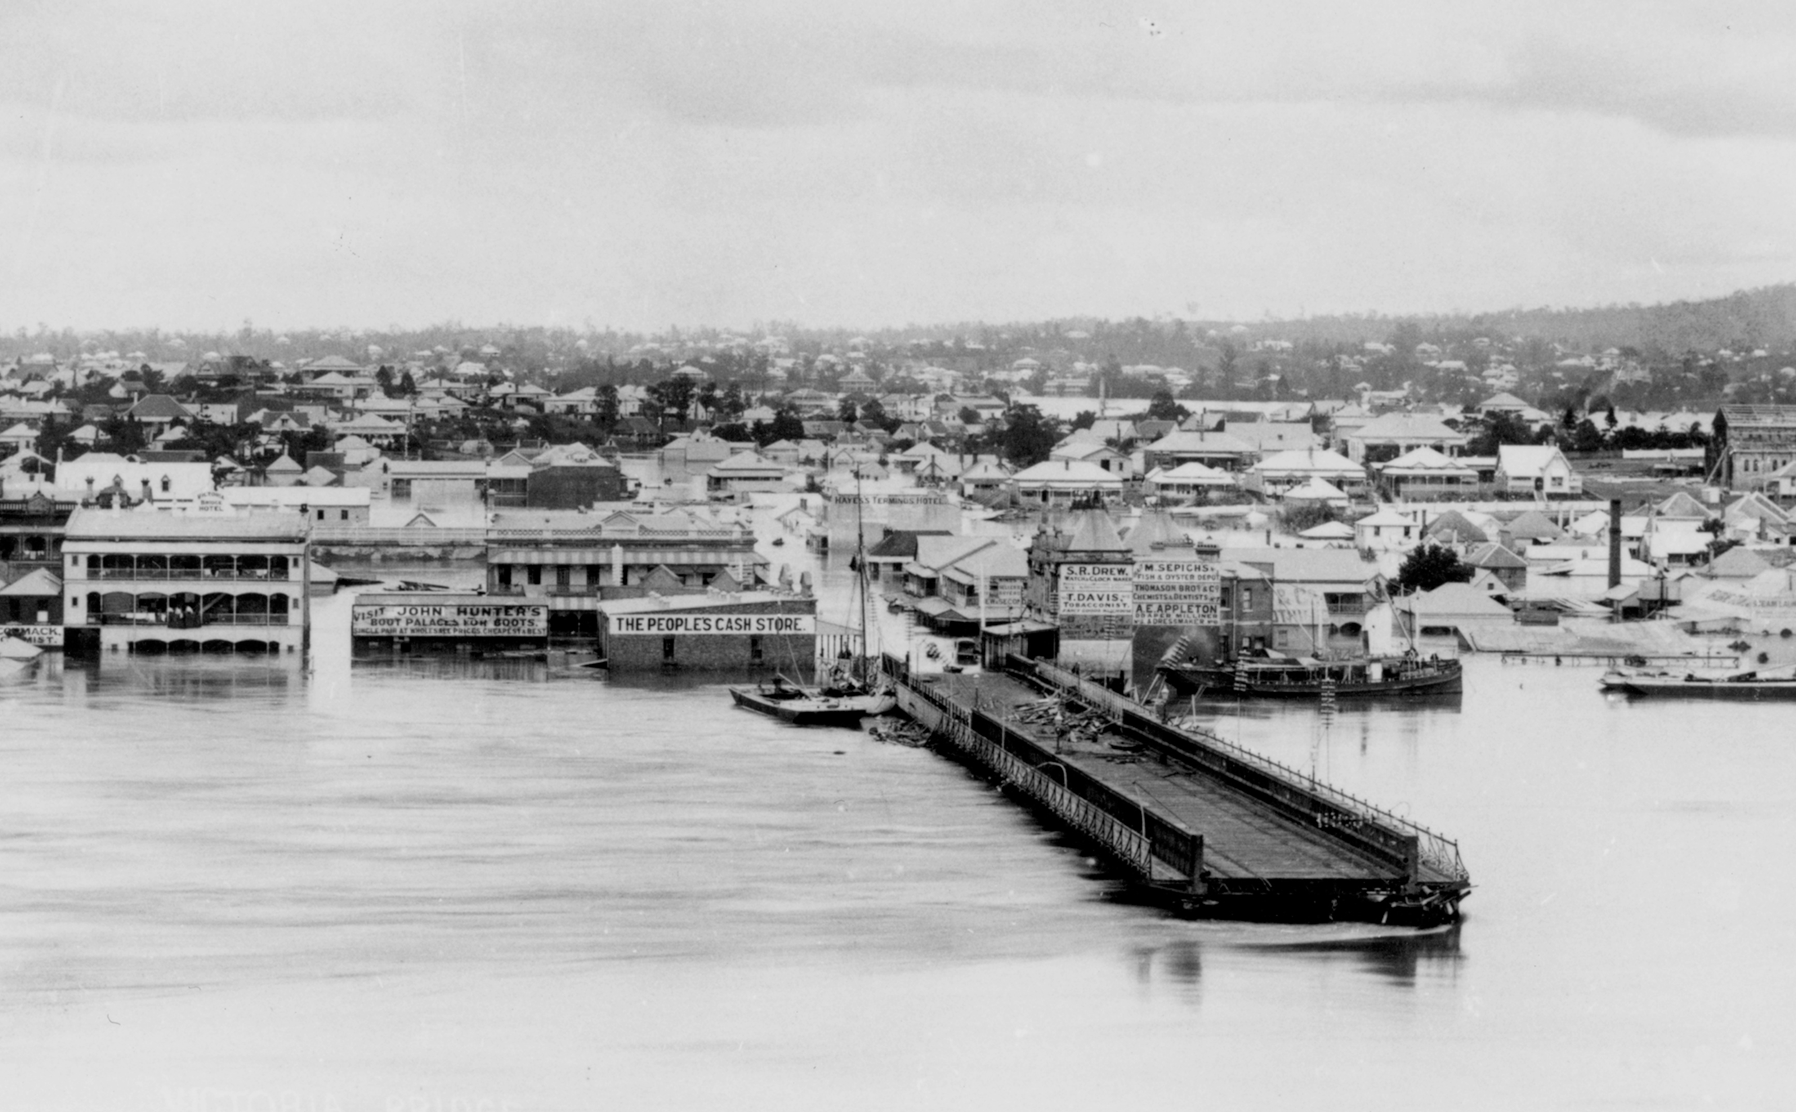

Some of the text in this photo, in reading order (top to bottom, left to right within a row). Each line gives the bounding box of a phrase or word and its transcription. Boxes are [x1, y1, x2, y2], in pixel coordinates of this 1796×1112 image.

[1092, 566, 1129, 576] DREW.
[1135, 584, 1176, 592] THOMASON
[354, 606, 541, 622] VISIT JOHN HUNTER'S
[1156, 604, 1218, 614] APPLETON
[371, 618, 402, 626] BOOT
[616, 617, 806, 632] THE PEOPLE'S CASH STORE.
